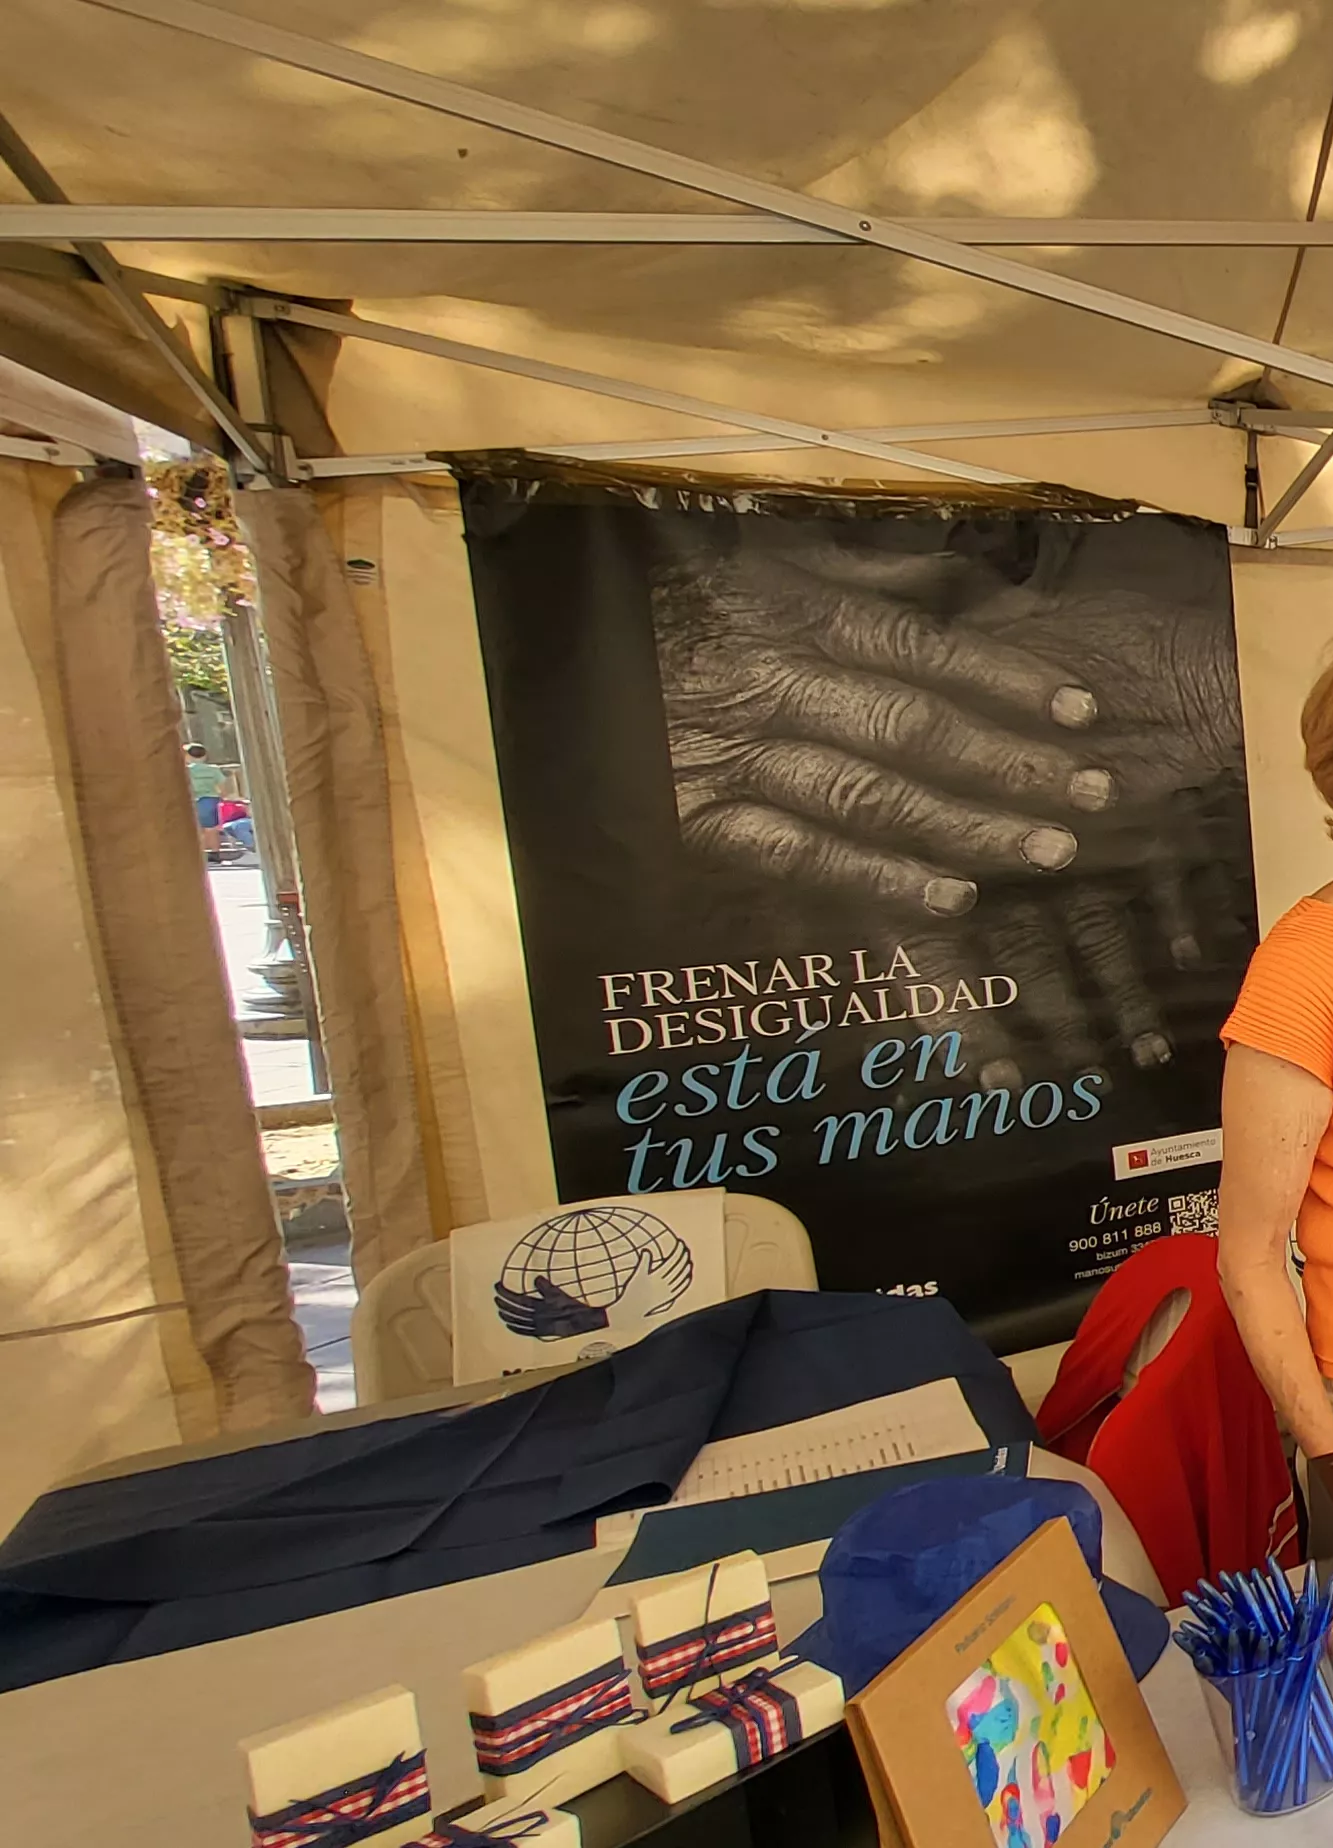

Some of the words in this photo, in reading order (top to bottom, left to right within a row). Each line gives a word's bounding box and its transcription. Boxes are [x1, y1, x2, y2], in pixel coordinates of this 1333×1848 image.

[599, 953, 836, 1013] FRENAR
[850, 945, 923, 990] LA
[604, 974, 1020, 1056] DESIGUALDAD
[616, 1024, 827, 1128] está
[862, 1028, 970, 1086] en
[624, 1118, 780, 1196] tus
[813, 1071, 1106, 1169] manos
[1150, 1137, 1216, 1157] Ayuntamiento
[1151, 1158, 1162, 1167] de
[1165, 1150, 1201, 1164] Huesca
[1090, 1196, 1159, 1225] Únete
[1069, 1235, 1098, 1252] 900
[1102, 1229, 1128, 1245] 811
[1135, 1222, 1161, 1237] 888
[1096, 1246, 1128, 1261] bizum
